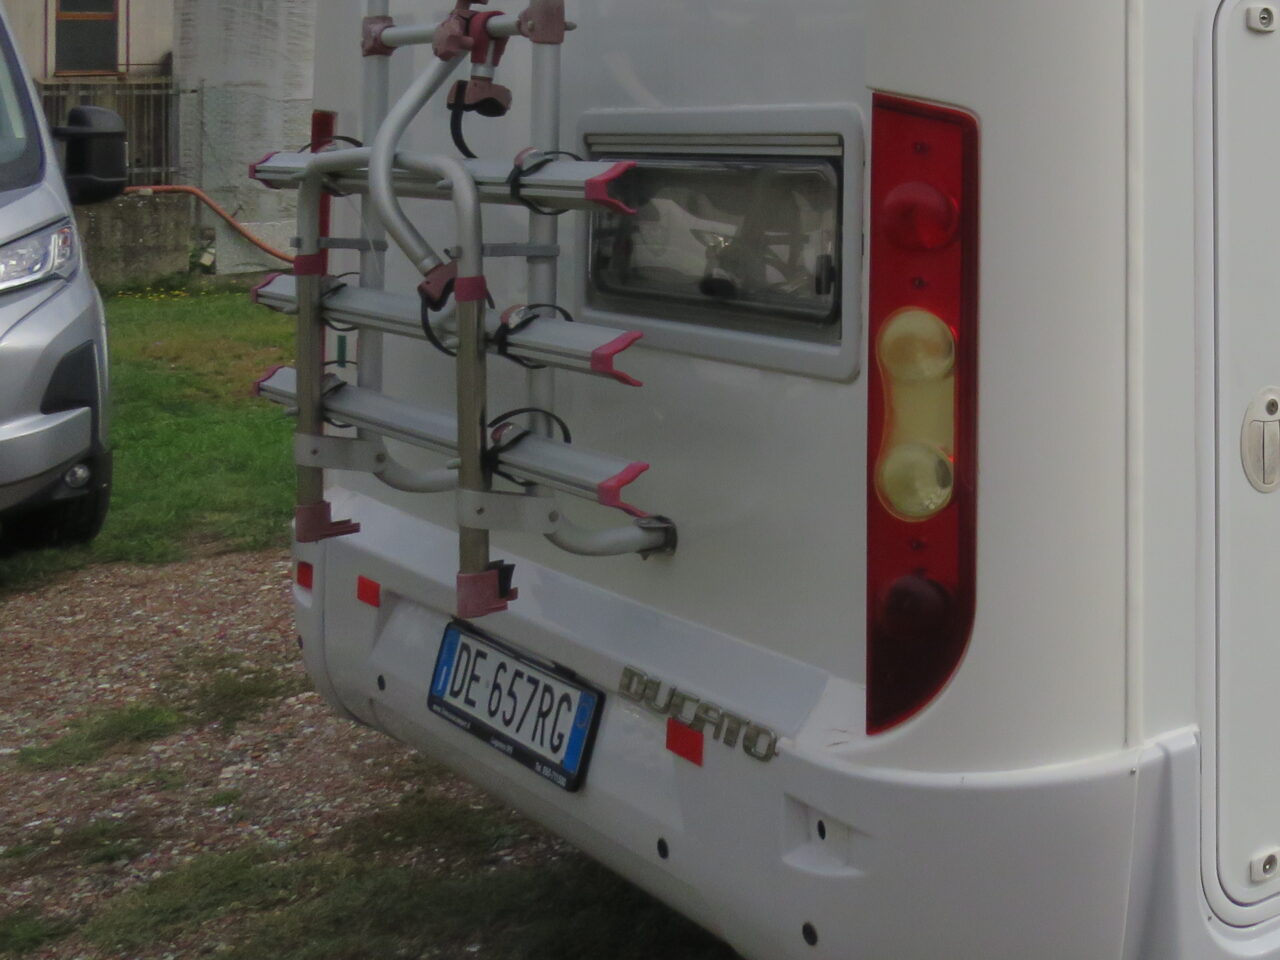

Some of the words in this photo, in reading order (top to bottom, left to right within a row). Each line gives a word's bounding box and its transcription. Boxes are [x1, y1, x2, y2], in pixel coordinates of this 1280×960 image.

[449, 641, 488, 708] DE
[488, 661, 573, 754] 657RG
[618, 664, 778, 762] DUCATO
